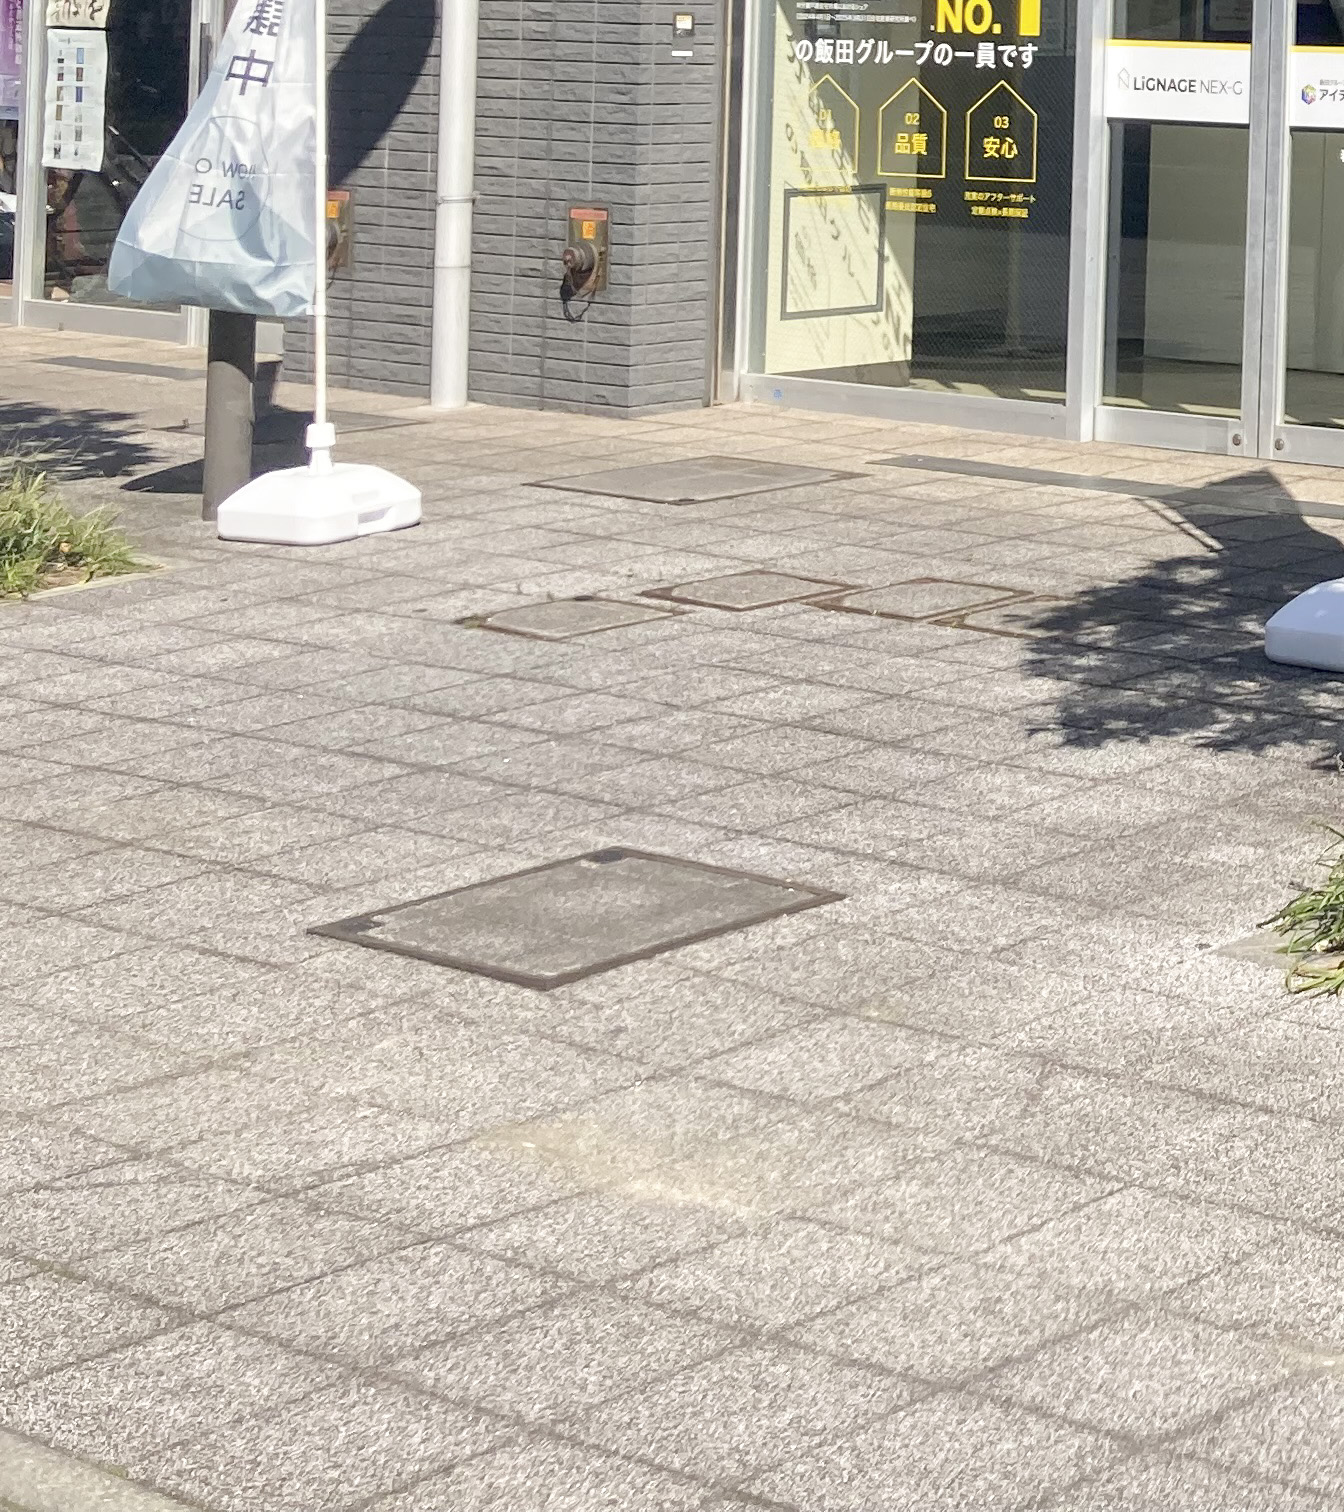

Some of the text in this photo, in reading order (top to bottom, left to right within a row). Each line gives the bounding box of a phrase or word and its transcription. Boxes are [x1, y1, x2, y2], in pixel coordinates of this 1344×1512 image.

[795, 38, 1039, 70] の飯田グループの一員です
[1133, 76, 1243, 95] LiGNAGE NEX-G
[904, 111, 920, 125] 02
[993, 115, 1009, 129] 03
[894, 132, 928, 155] 品質
[982, 136, 1018, 159] 安心
